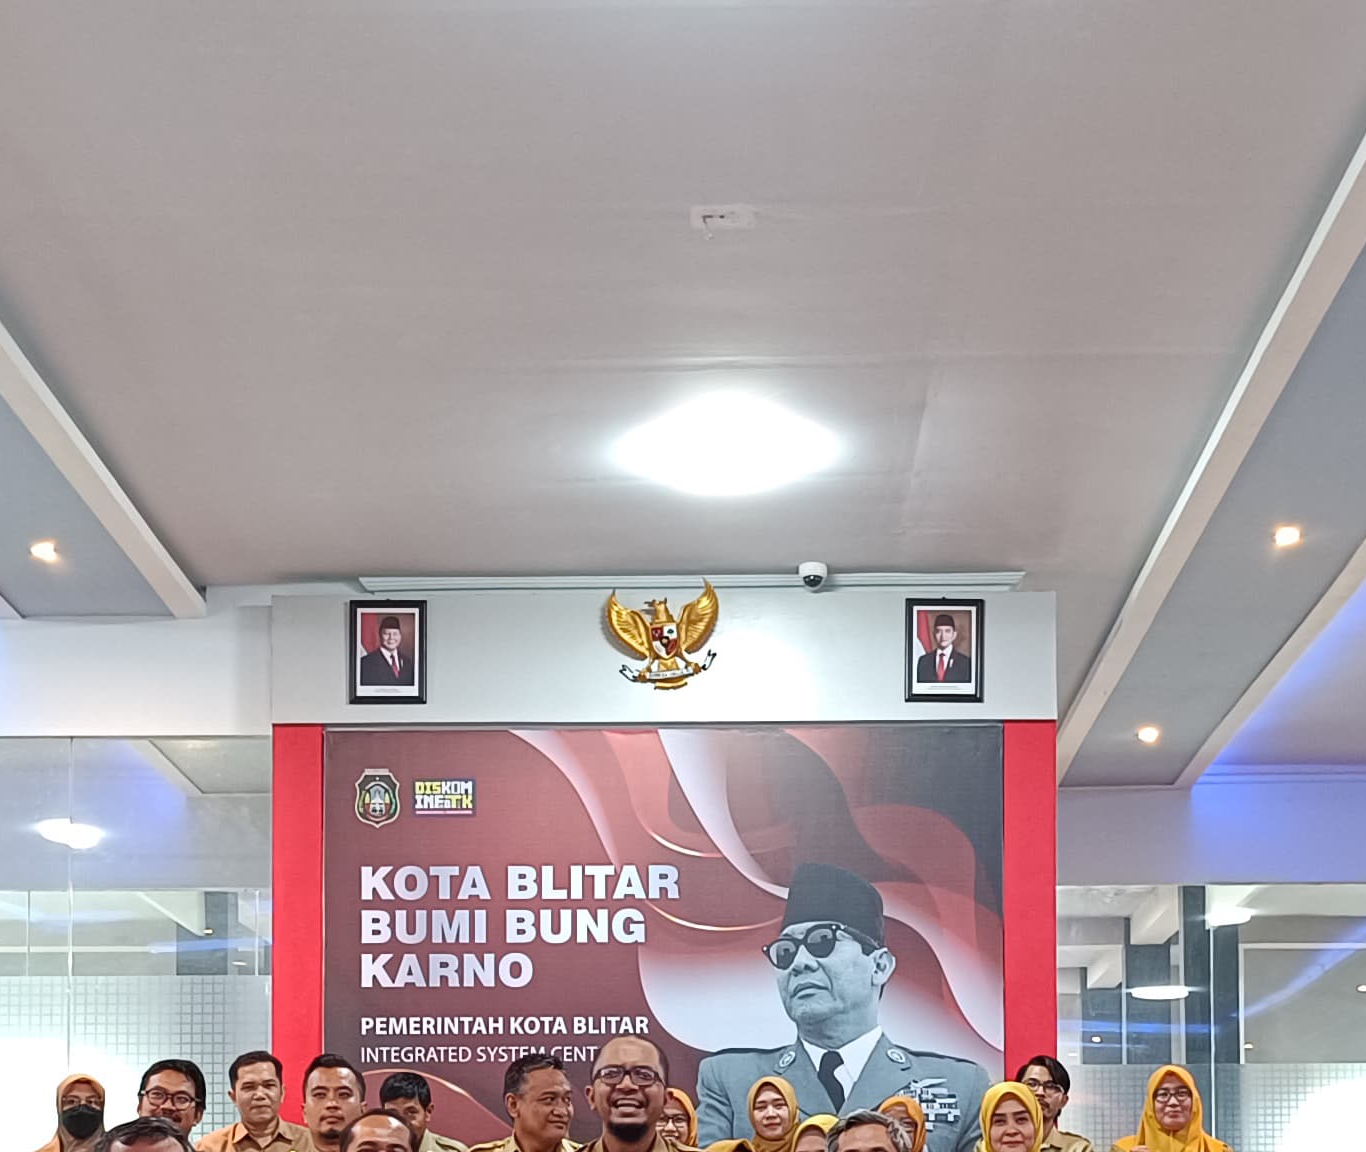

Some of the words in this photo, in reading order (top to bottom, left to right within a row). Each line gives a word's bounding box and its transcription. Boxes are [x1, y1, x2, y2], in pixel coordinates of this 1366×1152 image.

[415, 781, 473, 795] DISKOM
[360, 865, 491, 901] KOTA
[506, 865, 681, 901] BLITAR
[360, 909, 488, 944] BUMI
[505, 908, 647, 945] BUNG
[360, 952, 534, 988] KARNO
[360, 1016, 504, 1035] PEMERINTAH
[510, 1016, 567, 1034] KOTA
[573, 1016, 649, 1034] BLITAR
[360, 1046, 472, 1063] INTEGRATED
